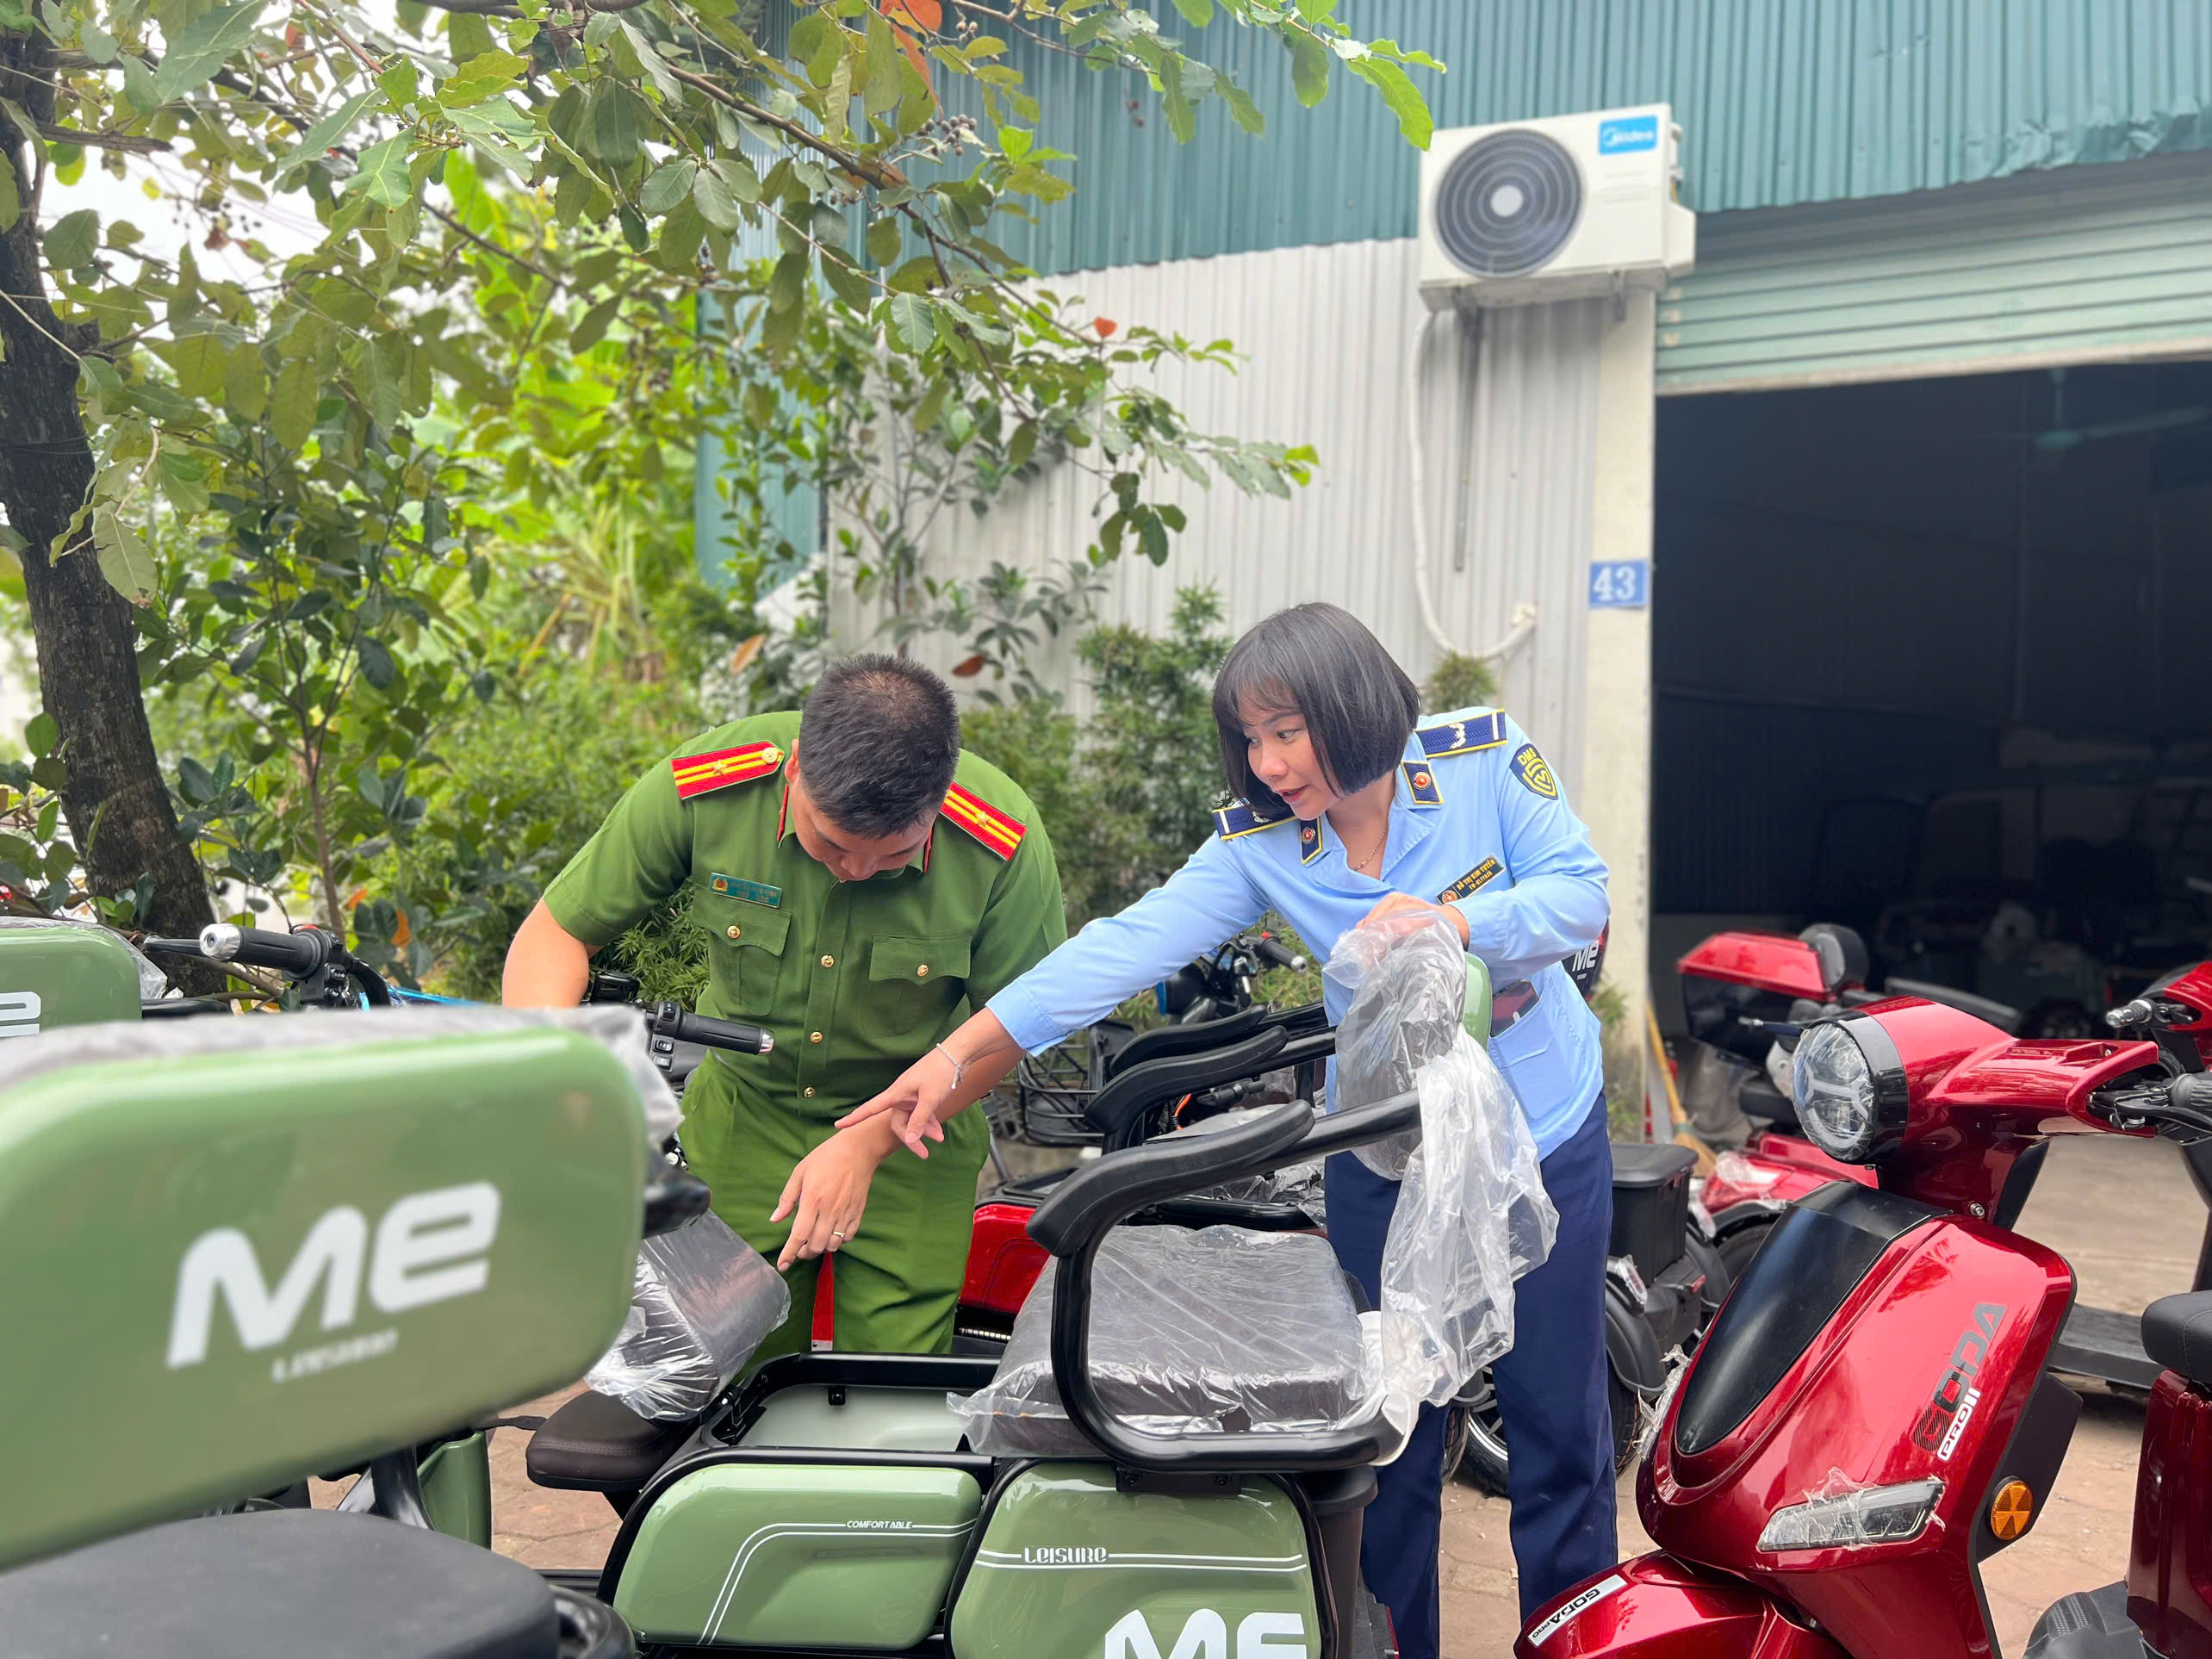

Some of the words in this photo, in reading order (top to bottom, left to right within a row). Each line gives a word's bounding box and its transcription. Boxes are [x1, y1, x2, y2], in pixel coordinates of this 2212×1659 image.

[1592, 566, 1636, 601] 43
[1517, 747, 1538, 766] DMS
[1910, 1302, 2009, 1452] GODA
[847, 1520, 913, 1529] COMFORTABLE
[1550, 1588, 1600, 1624] GODA
